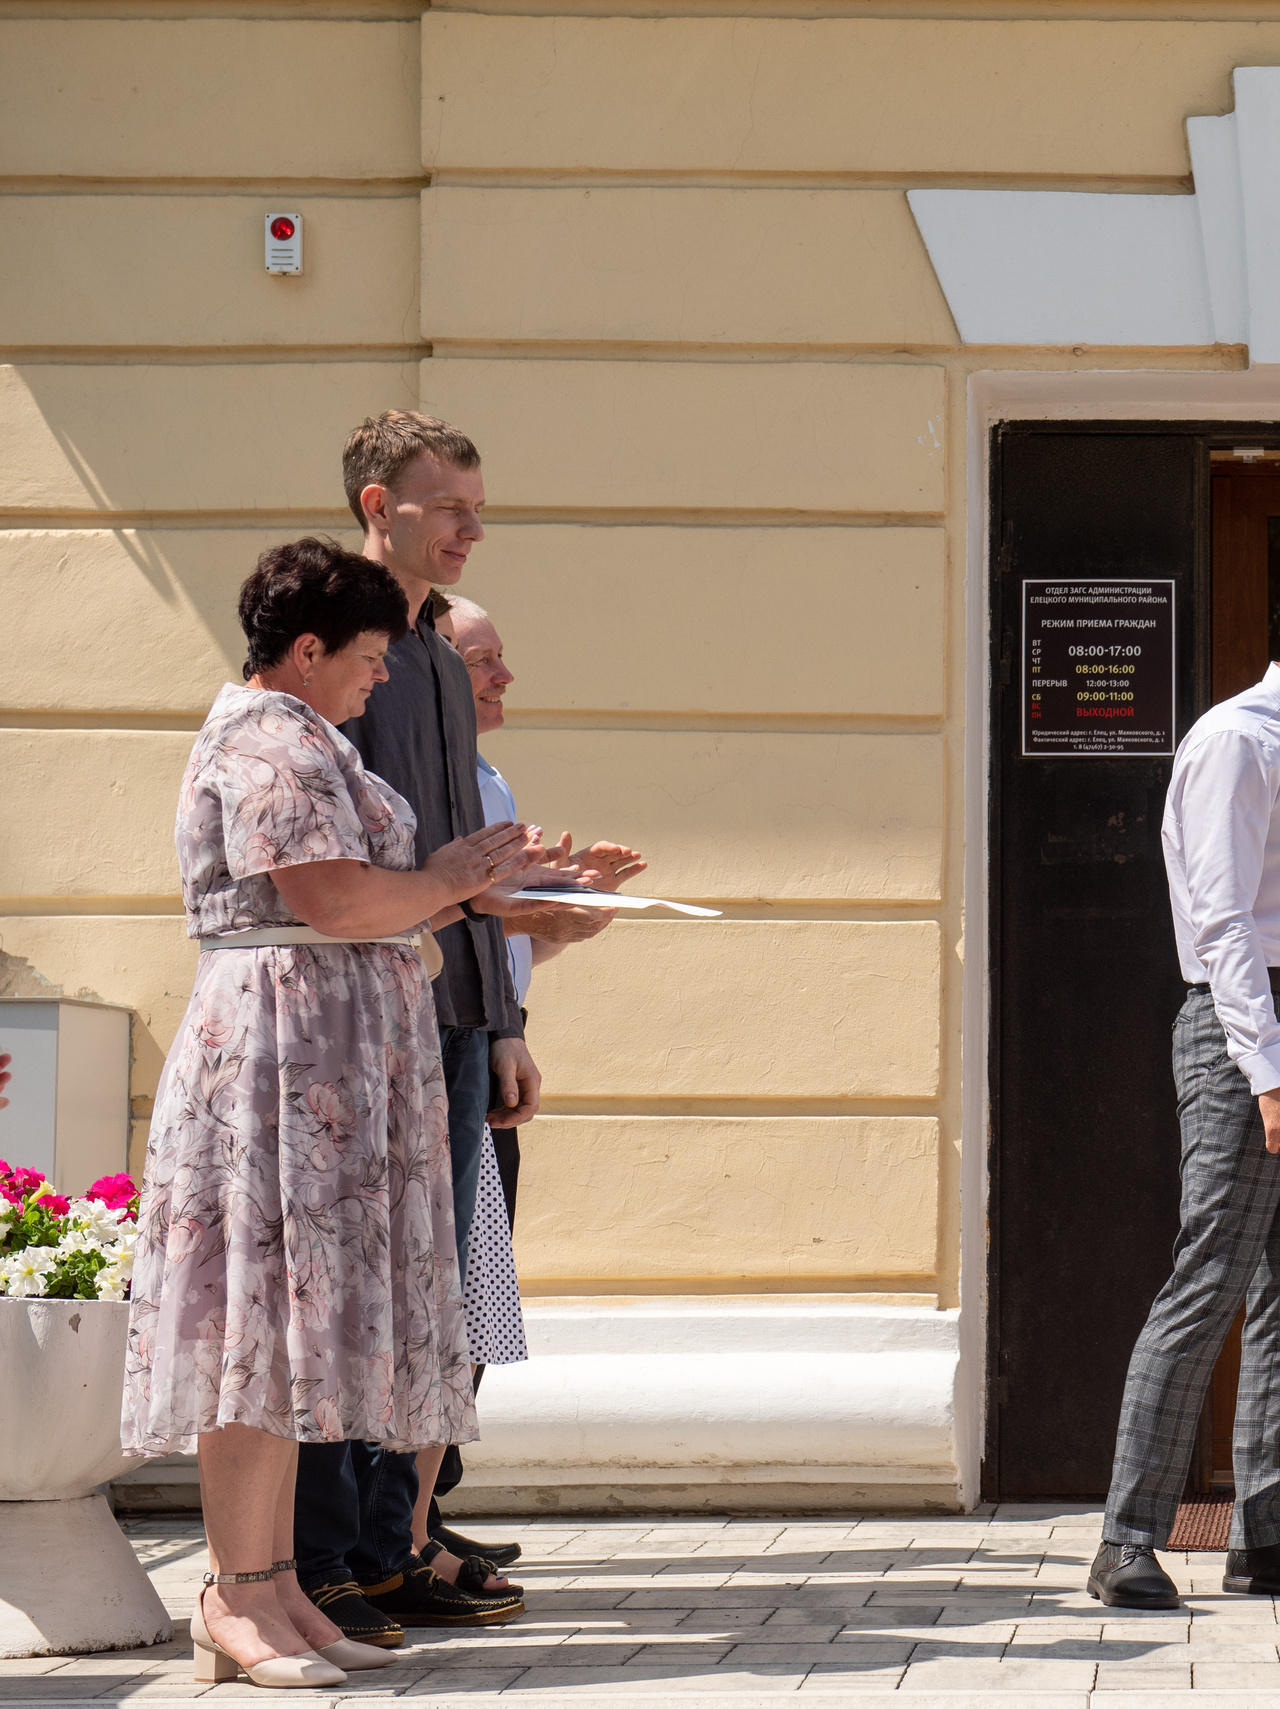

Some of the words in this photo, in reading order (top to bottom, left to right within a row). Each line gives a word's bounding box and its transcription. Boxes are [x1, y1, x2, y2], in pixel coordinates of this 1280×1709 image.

[1045, 587, 1069, 595] ОТДЕЛ
[1088, 587, 1152, 595] АДМИНИСТРАЦИИ
[1030, 596, 1067, 604] ЕЛЕЦКОГО
[1068, 596, 1137, 604] МУНИЦИПАЛЬНОГО
[1138, 596, 1167, 604] РАЙОНА
[1041, 619, 1075, 628] РЕЖИМ
[1076, 619, 1113, 628] ПРИЕМА
[1114, 619, 1156, 629] ГРАЖДАН
[1032, 639, 1041, 647] ВТ
[1032, 648, 1041, 656] СР
[1068, 645, 1141, 656] 08:00-17:00
[1032, 657, 1041, 665] ЧТ
[1032, 666, 1041, 674] ПТ
[1075, 664, 1135, 674] 08:00-16:00
[1032, 679, 1068, 687] ПЕРЕРЫВ
[1086, 679, 1130, 688] 12:00-13:00
[1031, 693, 1042, 701] СБ
[1076, 691, 1135, 701] 09:00-11:00
[1031, 711, 1042, 719] ПН
[1076, 707, 1134, 718] ВЫХОДНОЙ
[1117, 729, 1156, 737] Маяковского,
[1116, 736, 1154, 744] Маяковского,
